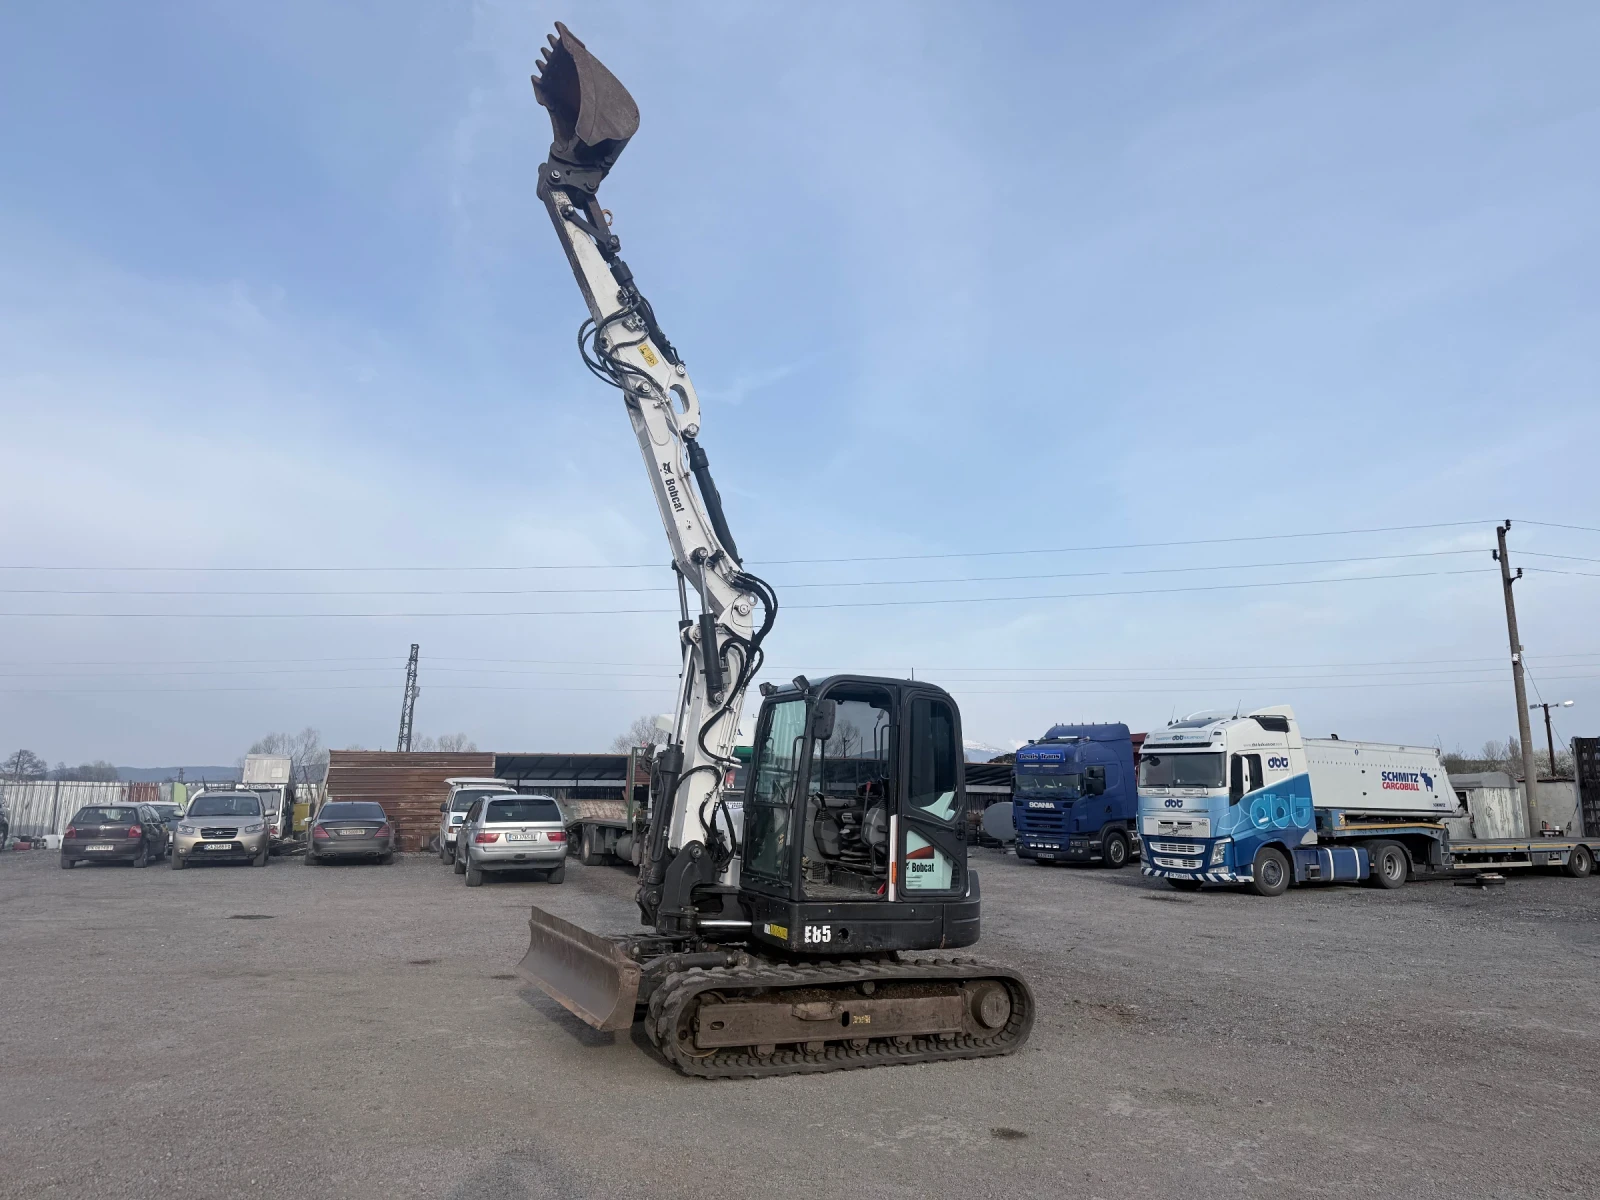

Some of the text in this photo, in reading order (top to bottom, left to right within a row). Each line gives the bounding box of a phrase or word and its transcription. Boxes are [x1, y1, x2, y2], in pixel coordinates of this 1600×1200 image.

[665, 478, 685, 513] Bobcat
[1267, 756, 1289, 769] dbt
[1381, 771, 1419, 783] SCHMITZ
[1382, 782, 1420, 791] CARGOBULL
[1028, 801, 1055, 809] SCANIA
[1164, 799, 1183, 808] dbt
[1249, 793, 1311, 830] dbt
[911, 862, 935, 873] Bobcat
